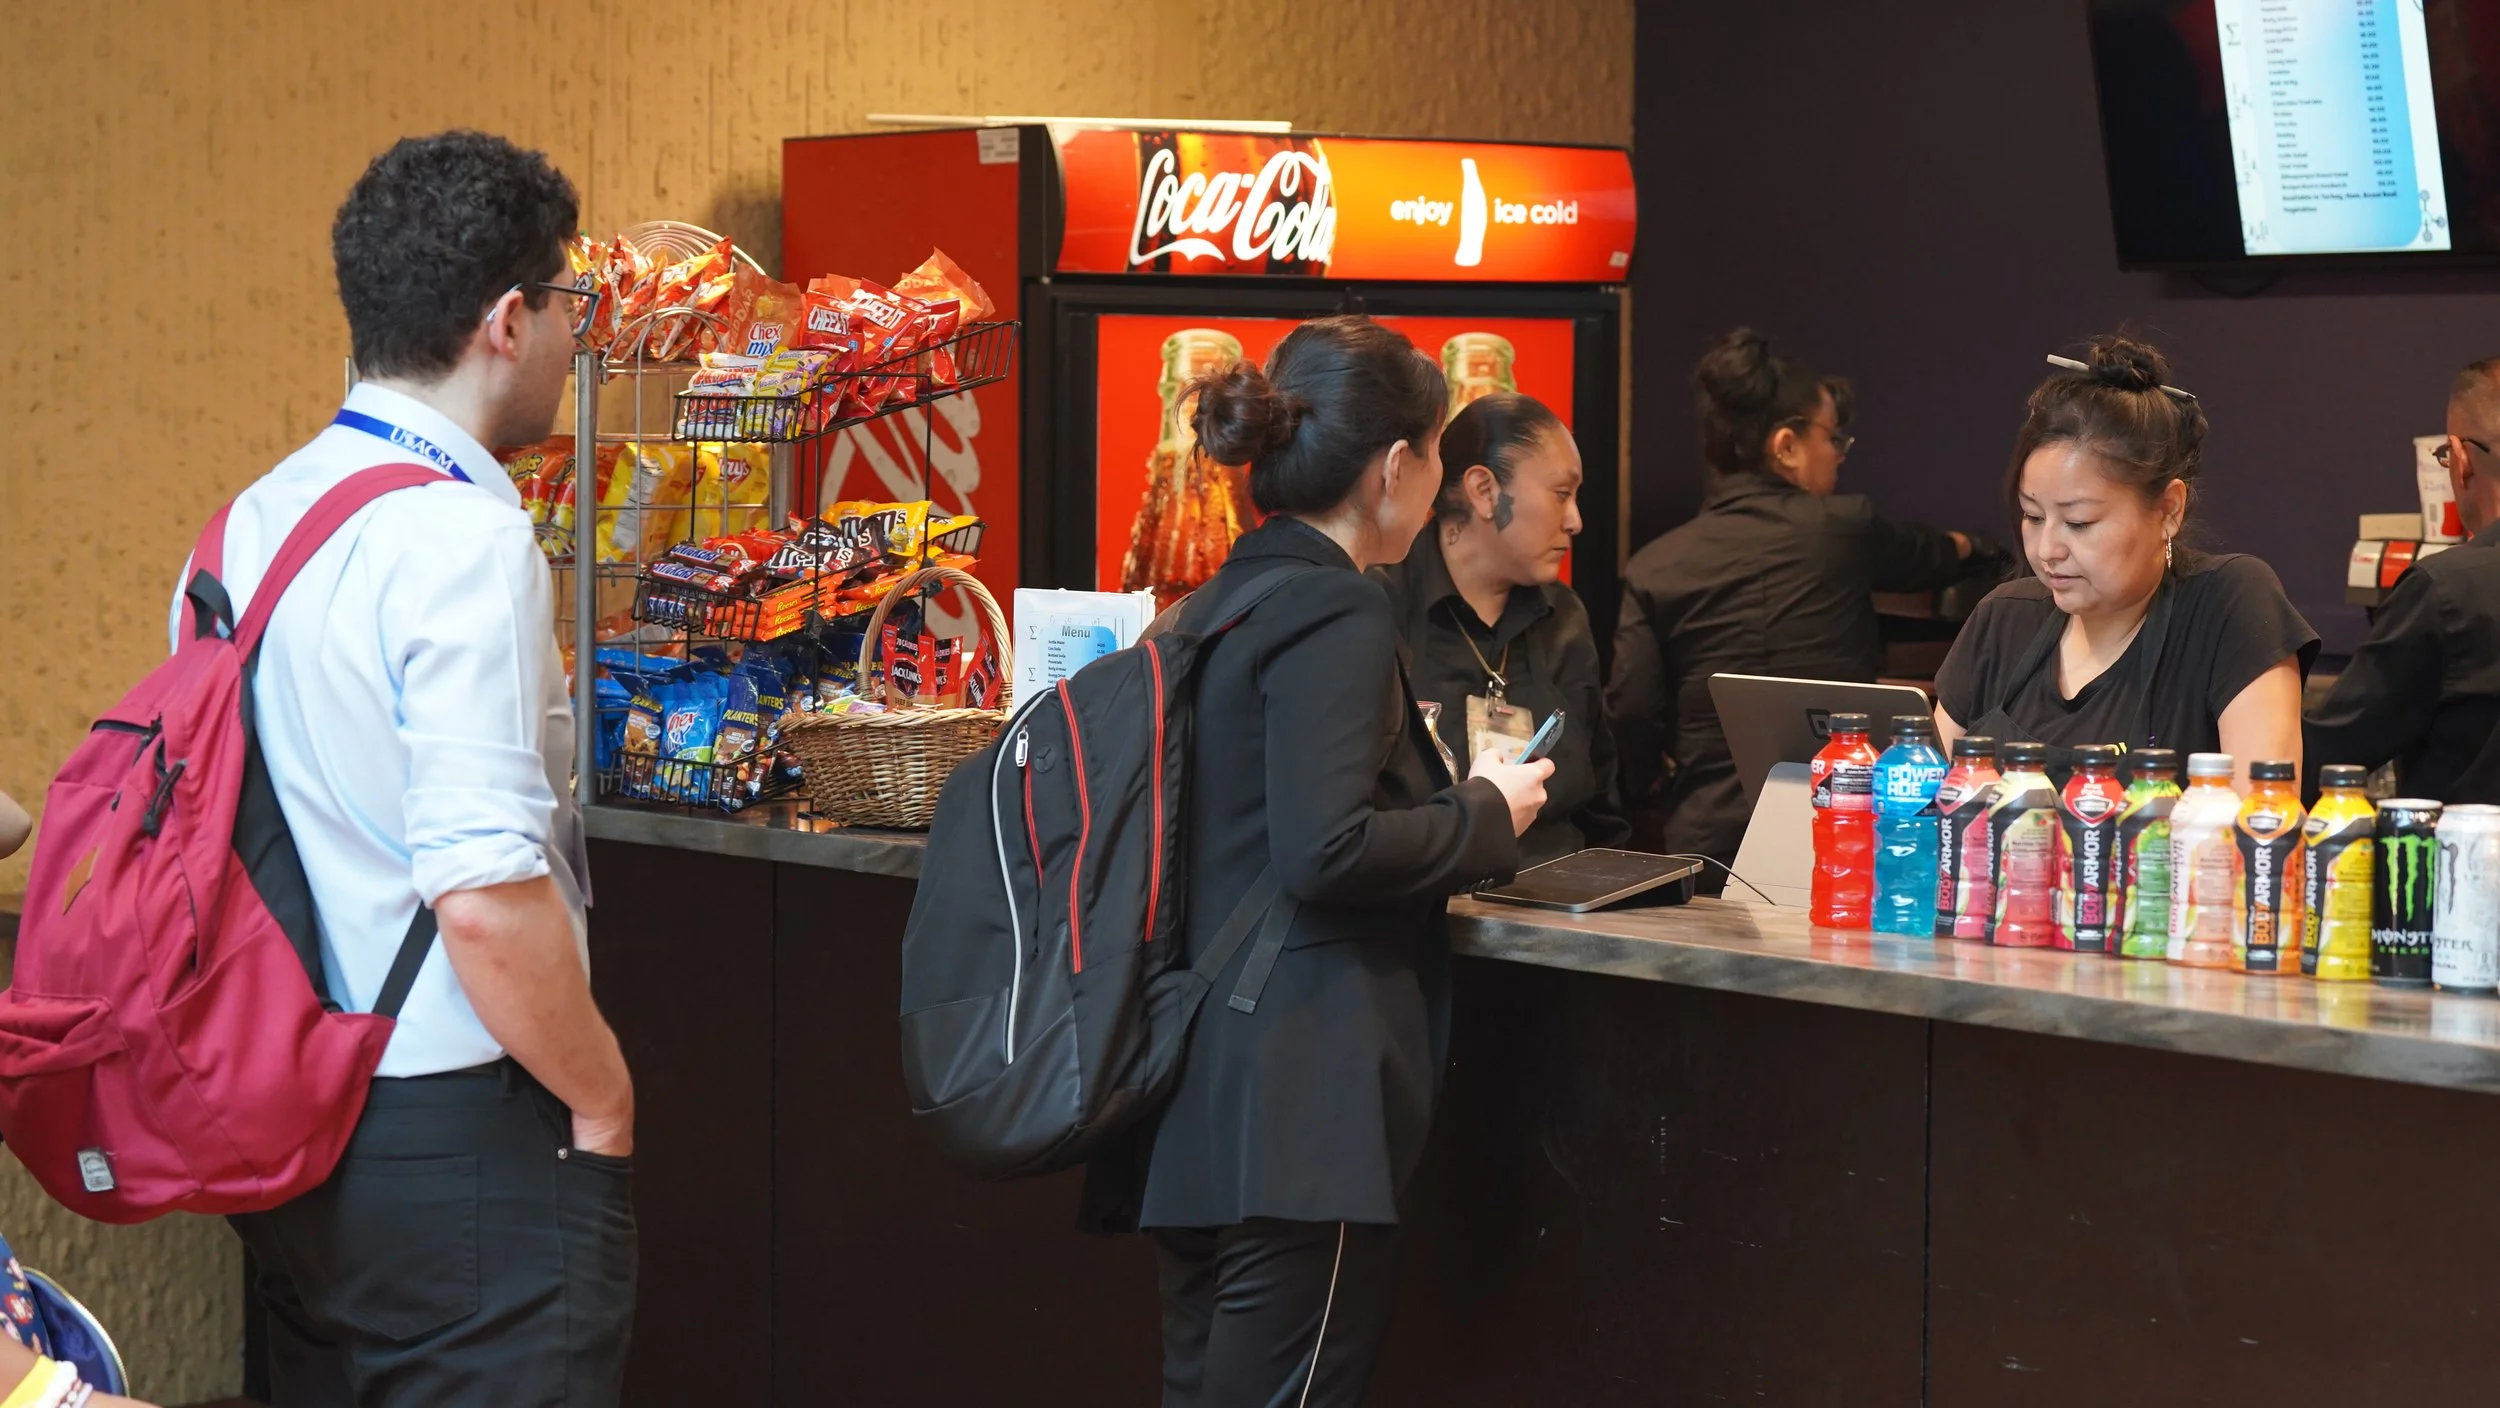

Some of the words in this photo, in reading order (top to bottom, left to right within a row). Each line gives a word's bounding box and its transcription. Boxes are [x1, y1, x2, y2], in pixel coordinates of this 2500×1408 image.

[1391, 198, 1453, 226] enjoy
[1494, 202, 1528, 224] ice
[1531, 202, 1578, 225] cold
[748, 322, 784, 341] Chex
[1061, 625, 1091, 639] Menu
[758, 694, 784, 710] ANTERS
[722, 709, 759, 726] PLANTERS
[1887, 782, 1922, 797] ADE
[2083, 829, 2101, 925] BODYARMOR
[2253, 846, 2273, 945] BODYARMOR
